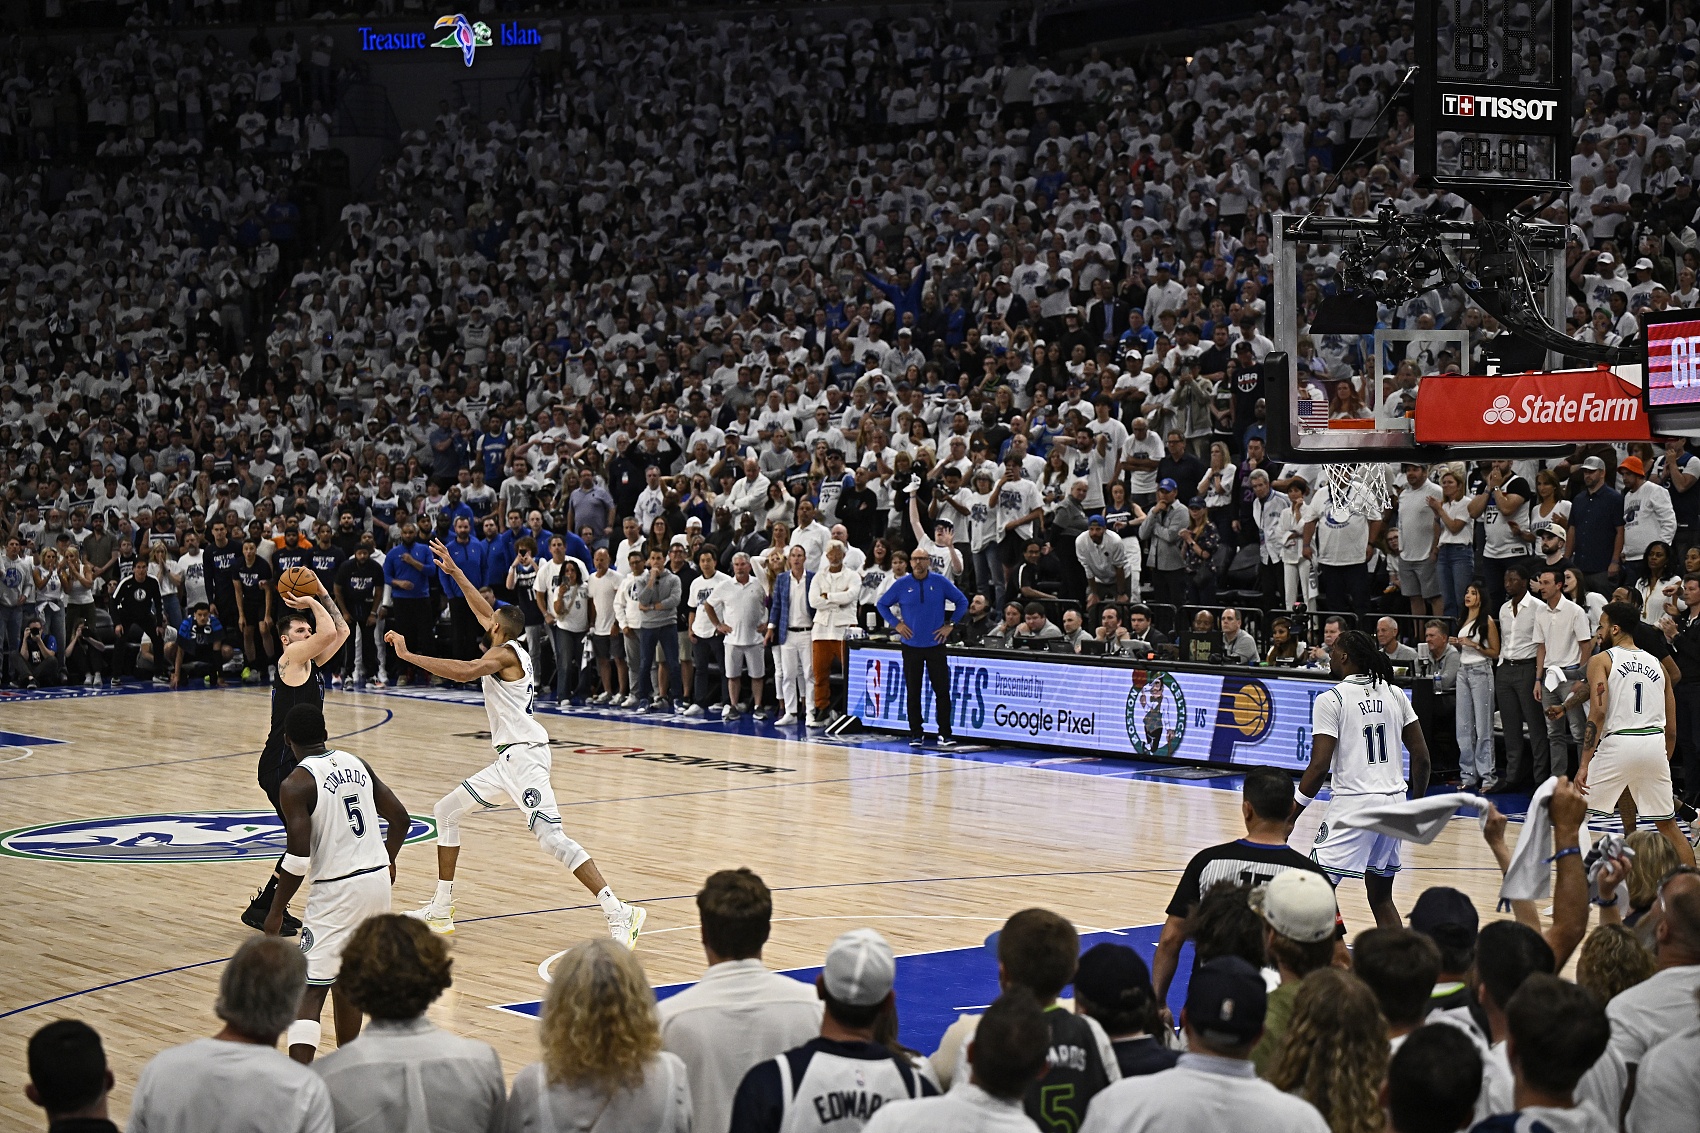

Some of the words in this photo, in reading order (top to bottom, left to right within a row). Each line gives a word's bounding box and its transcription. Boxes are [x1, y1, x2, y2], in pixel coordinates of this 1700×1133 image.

[358, 27, 426, 51] Treasure
[1475, 96, 1558, 121] TISSOT
[1238, 372, 1258, 382] USA
[1486, 512, 1498, 524] 27
[995, 672, 1033, 698] Presented
[1034, 676, 1044, 703] by
[1617, 661, 1661, 683] ANDERSON
[1171, 682, 1186, 739] CELTICS
[1358, 699, 1383, 715] REID
[1633, 682, 1643, 714] 1
[994, 703, 1053, 736] Google
[1057, 709, 1095, 735] Pixel
[1126, 689, 1139, 745] BOSTON
[1194, 708, 1207, 728] VS
[1363, 723, 1388, 764] 11
[323, 768, 367, 794] EDWARDS
[342, 794, 366, 838] 5
[813, 1089, 892, 1125] EDWAR
[1041, 1083, 1081, 1133] 5
